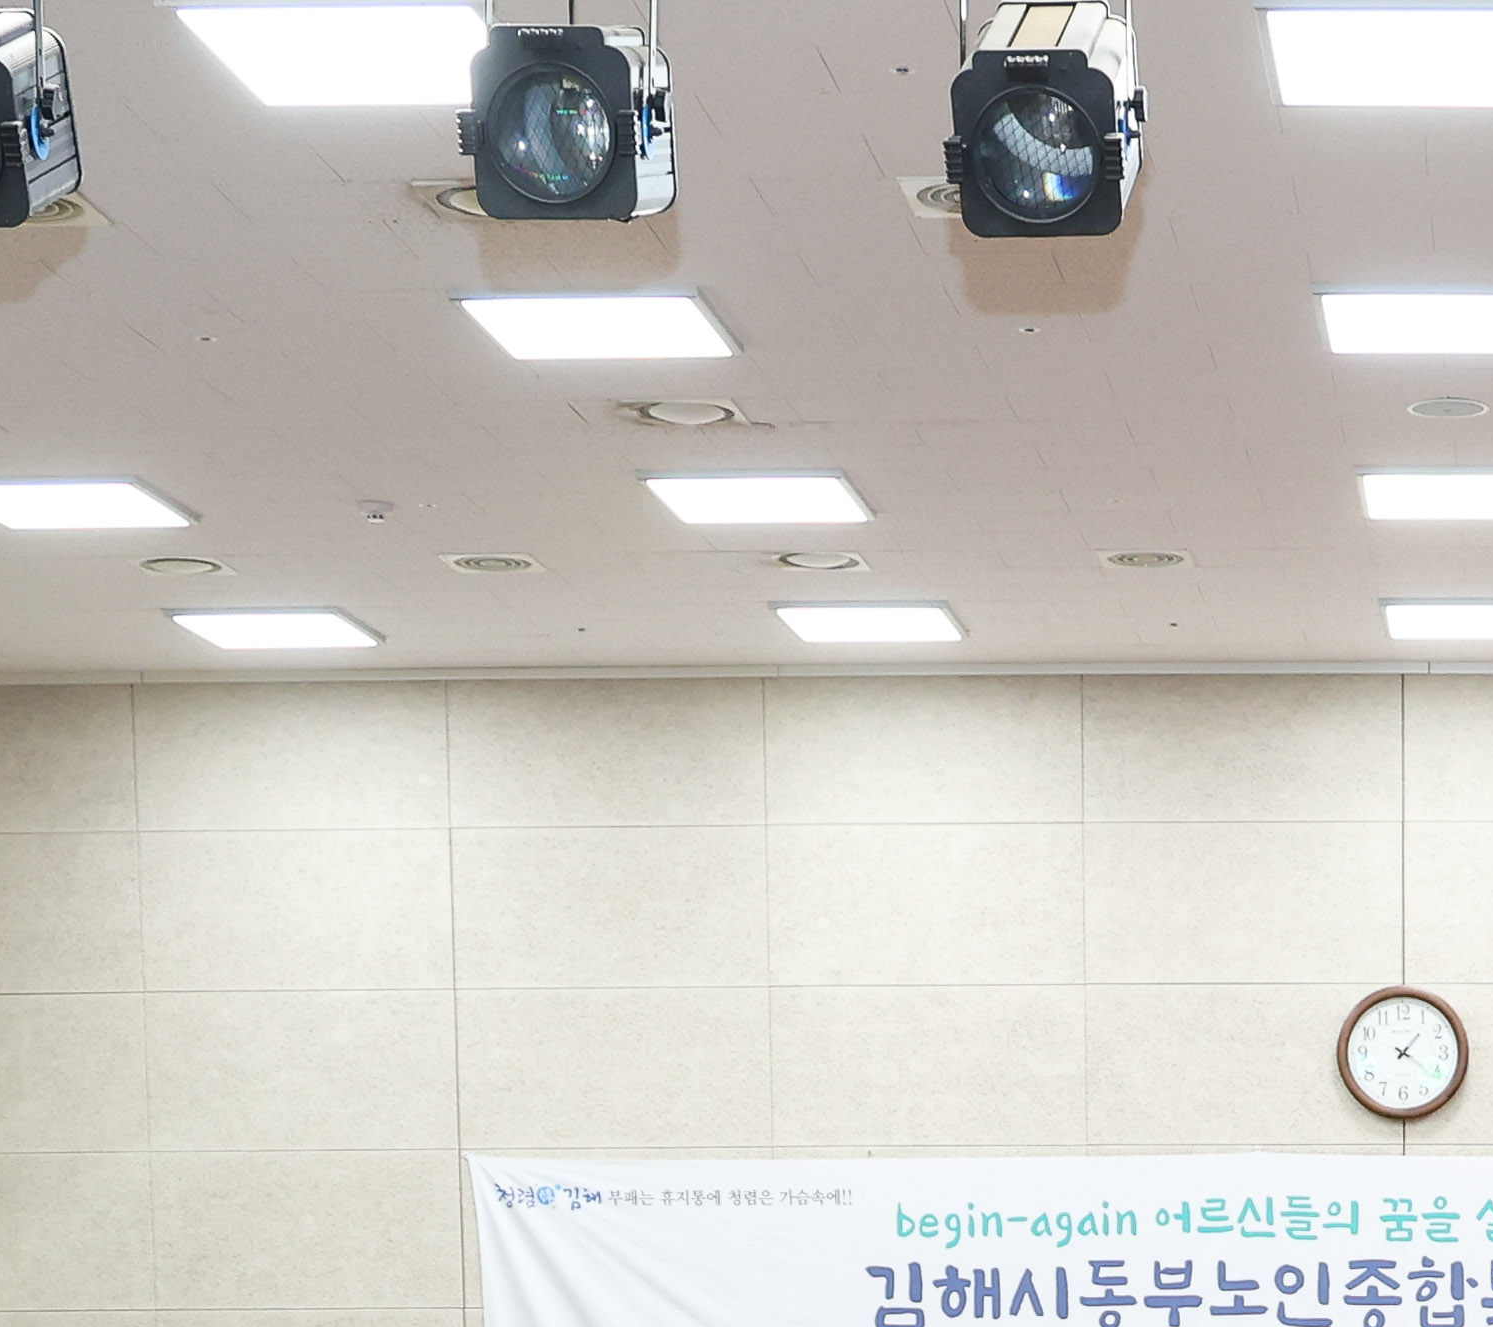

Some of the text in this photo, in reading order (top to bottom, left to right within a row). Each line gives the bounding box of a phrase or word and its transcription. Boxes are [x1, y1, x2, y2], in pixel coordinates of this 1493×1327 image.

[1378, 1010, 1388, 1025] 11
[1397, 1004, 1411, 1020] 12
[1363, 1026, 1375, 1041] 10
[1433, 1024, 1442, 1039] 2
[1357, 1045, 1367, 1059] 9
[1439, 1044, 1449, 1060] 3
[1379, 1081, 1387, 1096] 7
[1398, 1085, 1408, 1101] 6
[563, 1186, 602, 1211] 김해
[660, 1189, 721, 1206] 휴지통에
[728, 1189, 774, 1206] 청렴은
[779, 1189, 852, 1206] 가슴속에!!
[897, 1202, 1137, 1248] begin-again
[1155, 1195, 1360, 1239] 어르신들의
[1380, 1197, 1460, 1242] 꿈을
